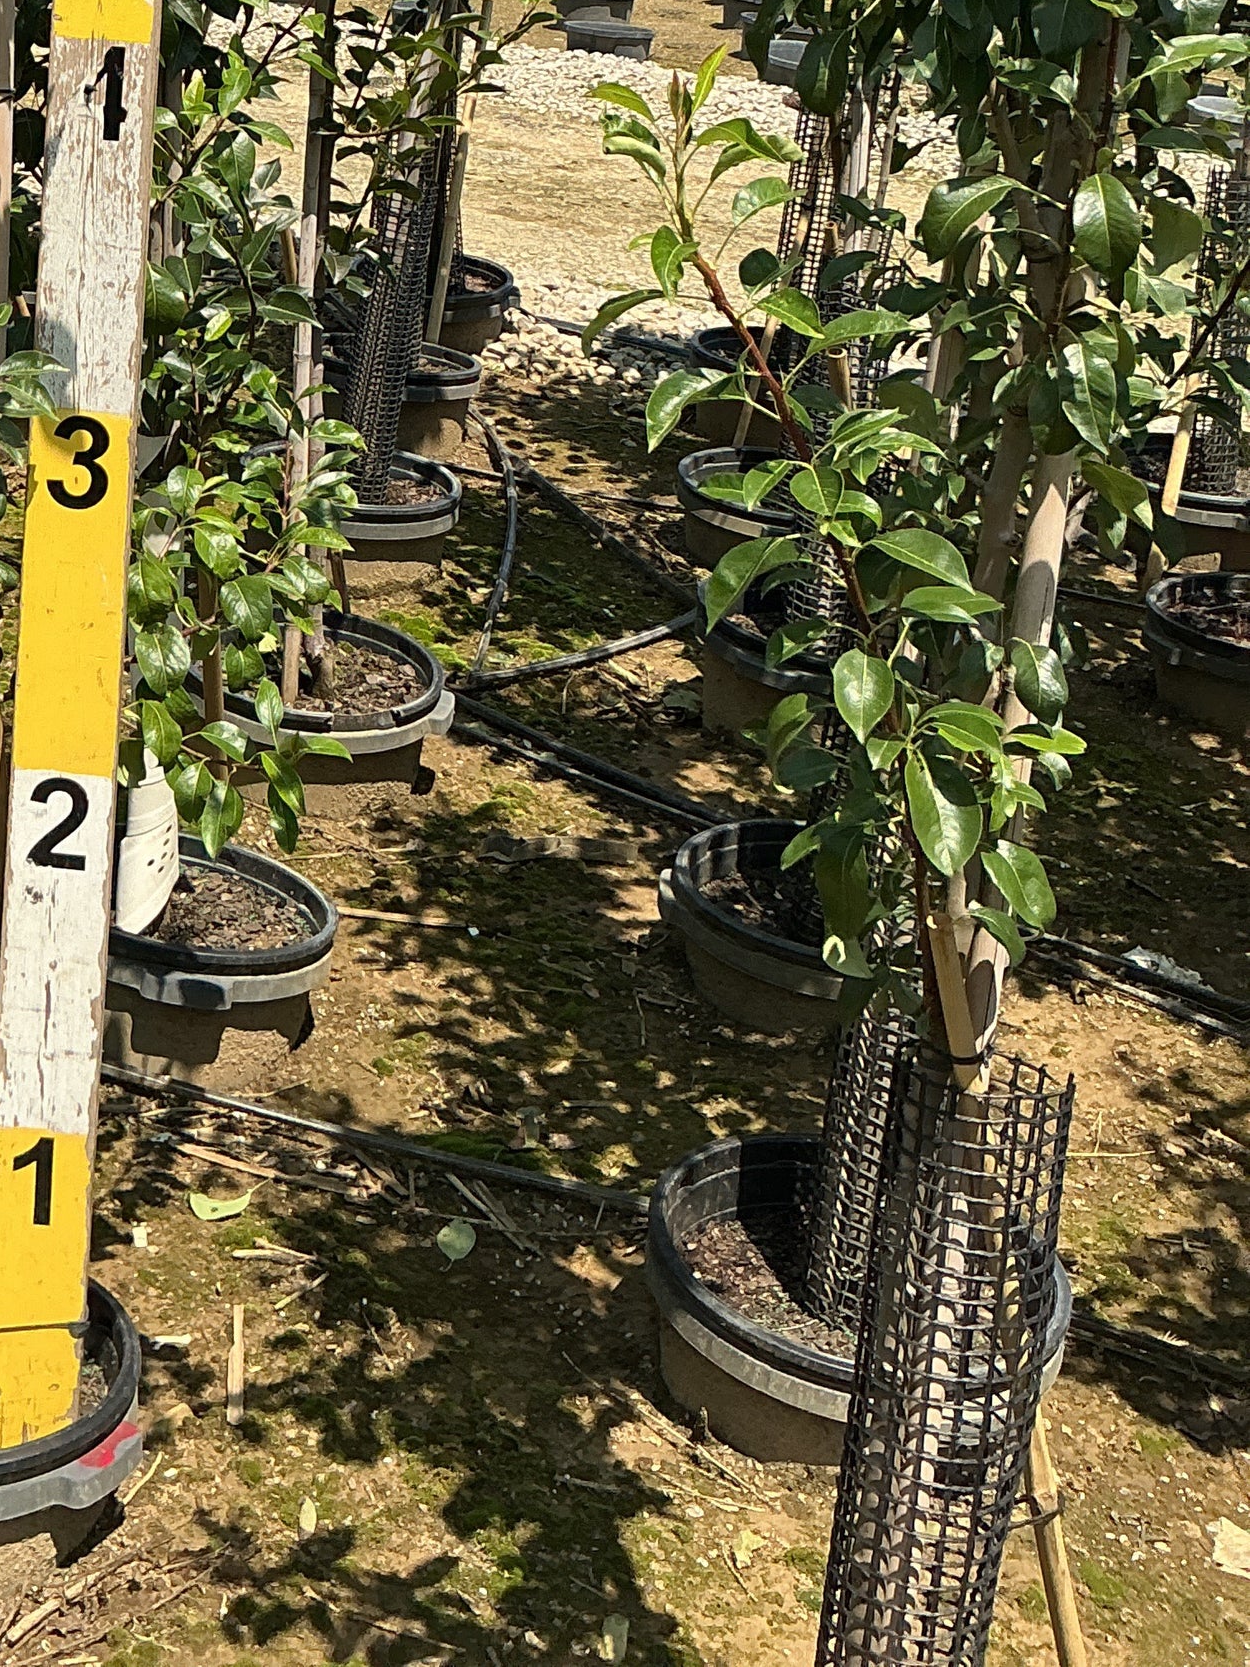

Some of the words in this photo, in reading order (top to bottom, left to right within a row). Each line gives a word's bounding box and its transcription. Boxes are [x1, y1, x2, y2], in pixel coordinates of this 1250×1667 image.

[46, 415, 111, 510] 3
[26, 777, 90, 871] 2
[12, 1137, 55, 1226] 1
